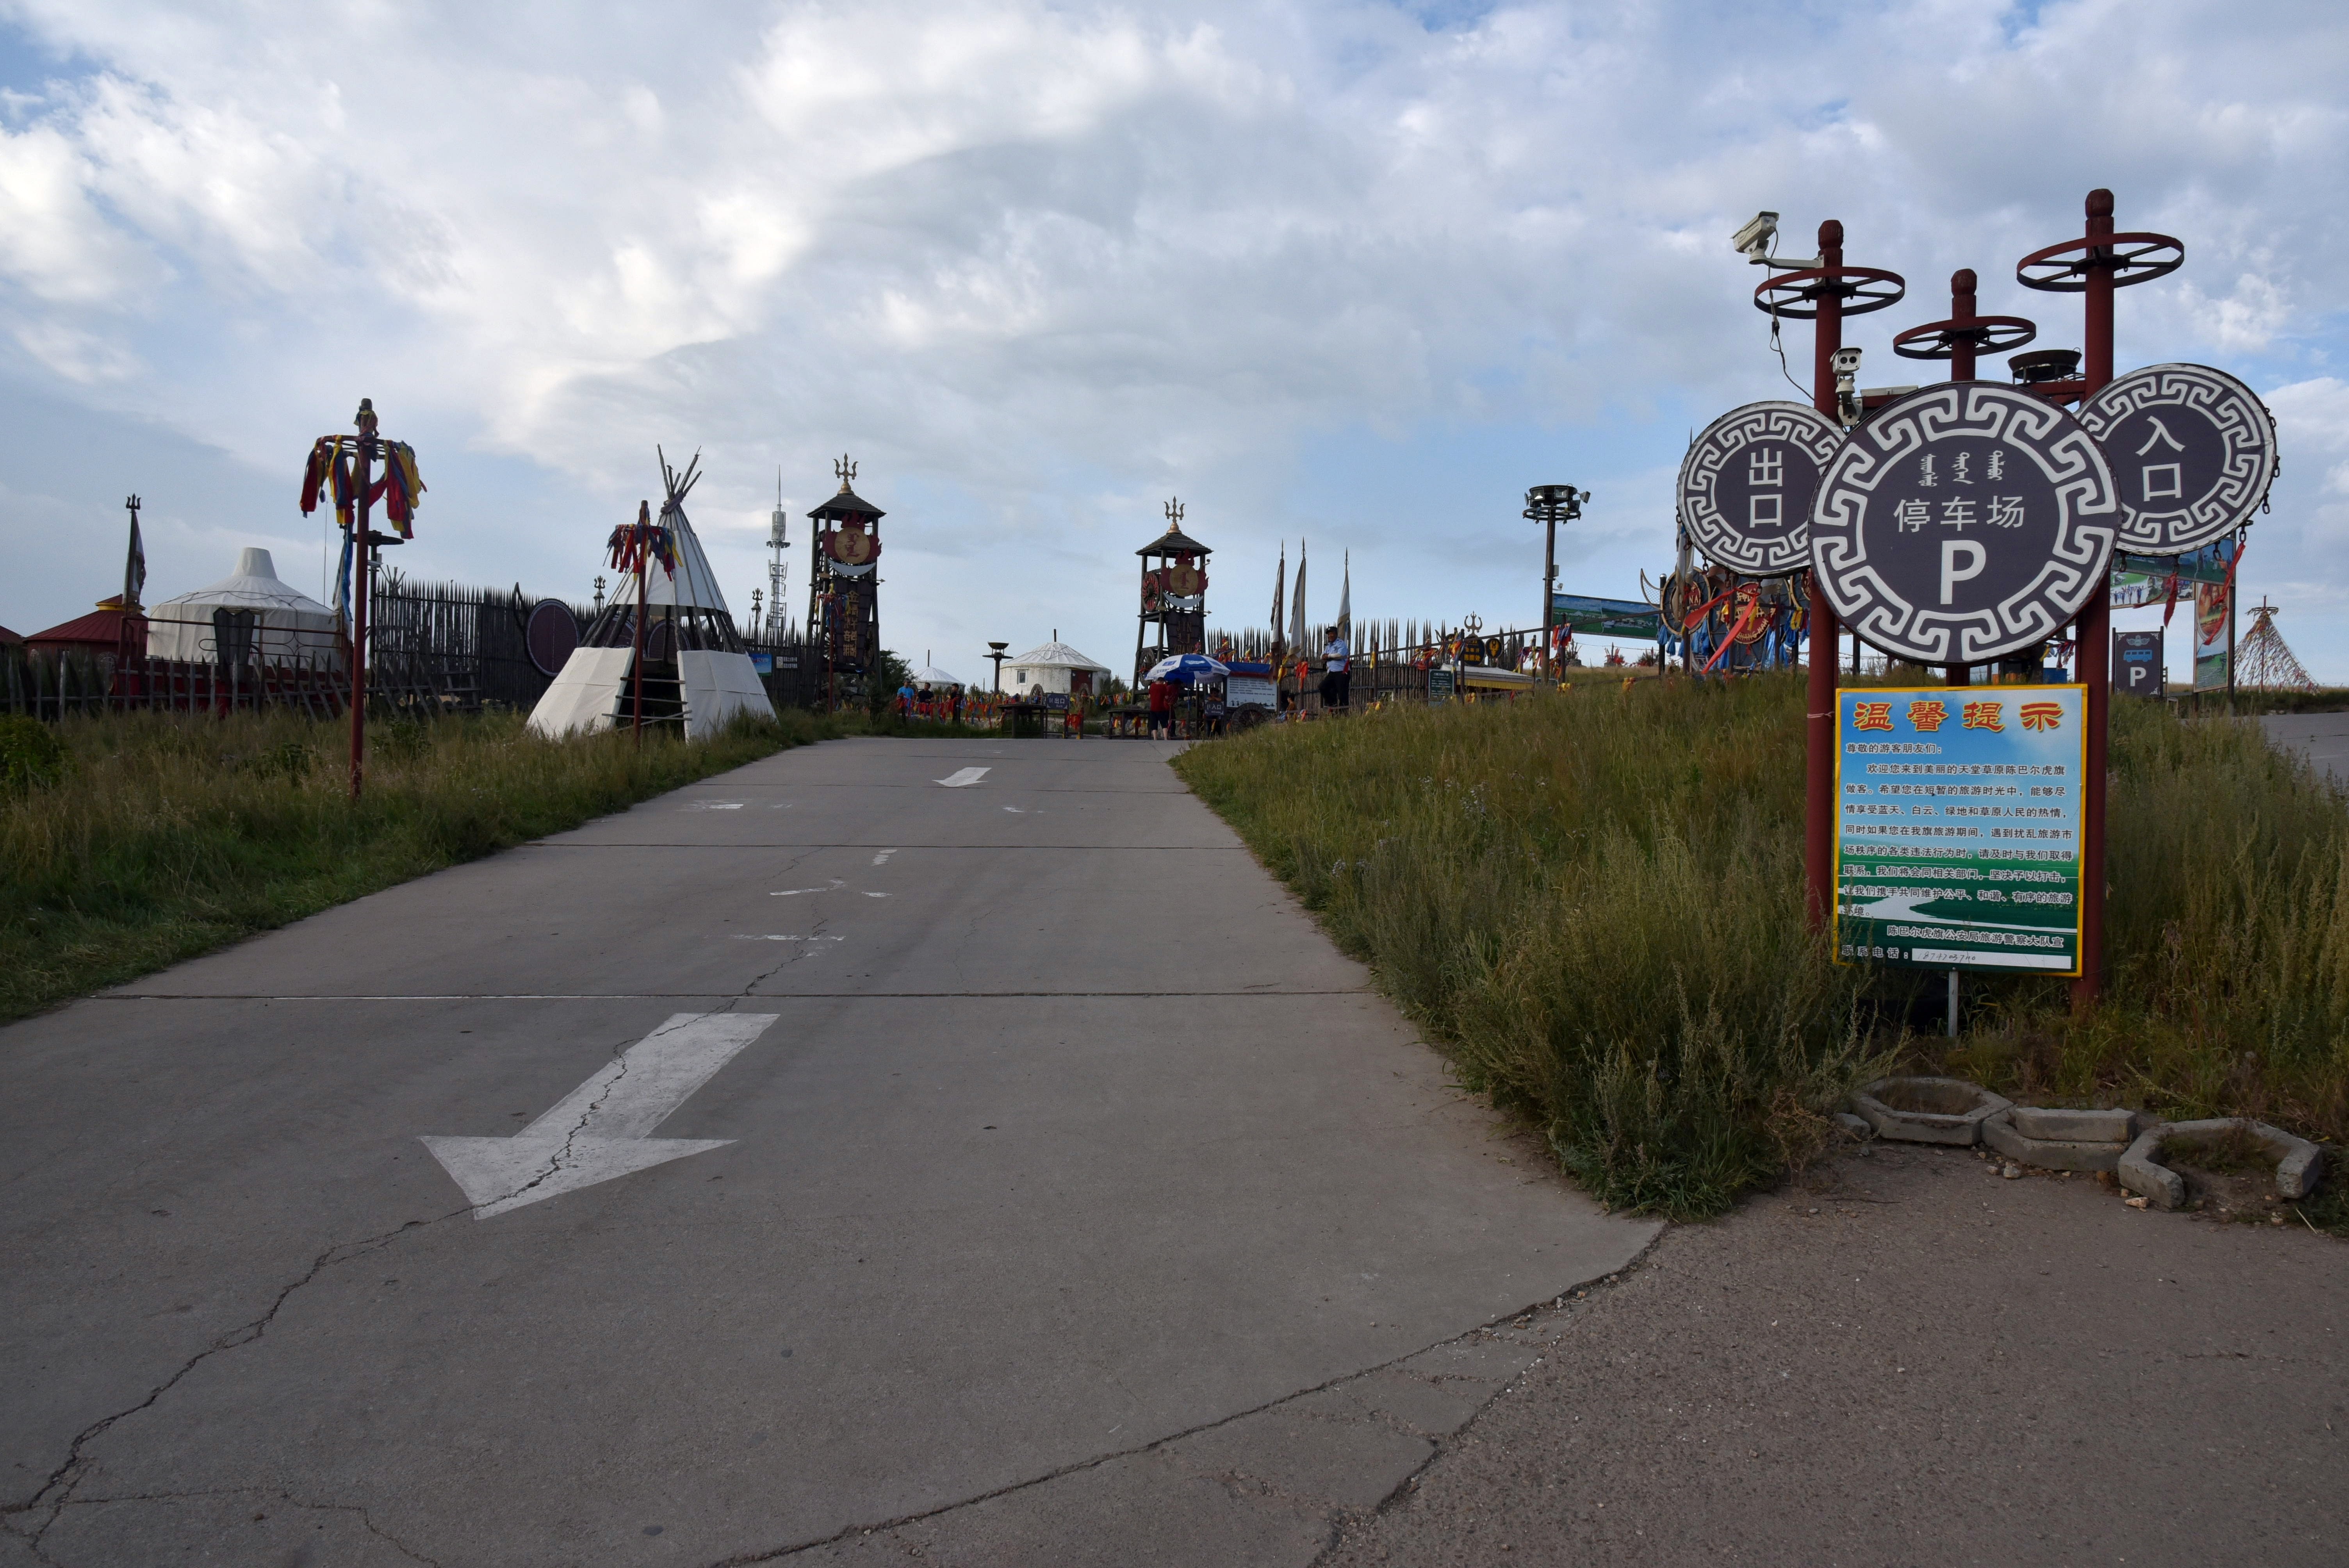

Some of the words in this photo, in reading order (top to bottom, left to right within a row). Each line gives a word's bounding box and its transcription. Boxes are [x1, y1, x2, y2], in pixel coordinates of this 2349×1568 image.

[2136, 415, 2185, 502] 入口
[1748, 448, 1783, 528] 出口
[1894, 496, 2024, 532] 停车场
[1941, 540, 1986, 604] P
[2130, 667, 2146, 686] P
[1853, 700, 2064, 732] 温馨提示
[1867, 763, 2066, 776] 欢迎您来到美丽的天堂草原陈巴尔虎旗
[1887, 925, 2064, 948] 陈巴尔虎旗公安局旅游警察大队宣
